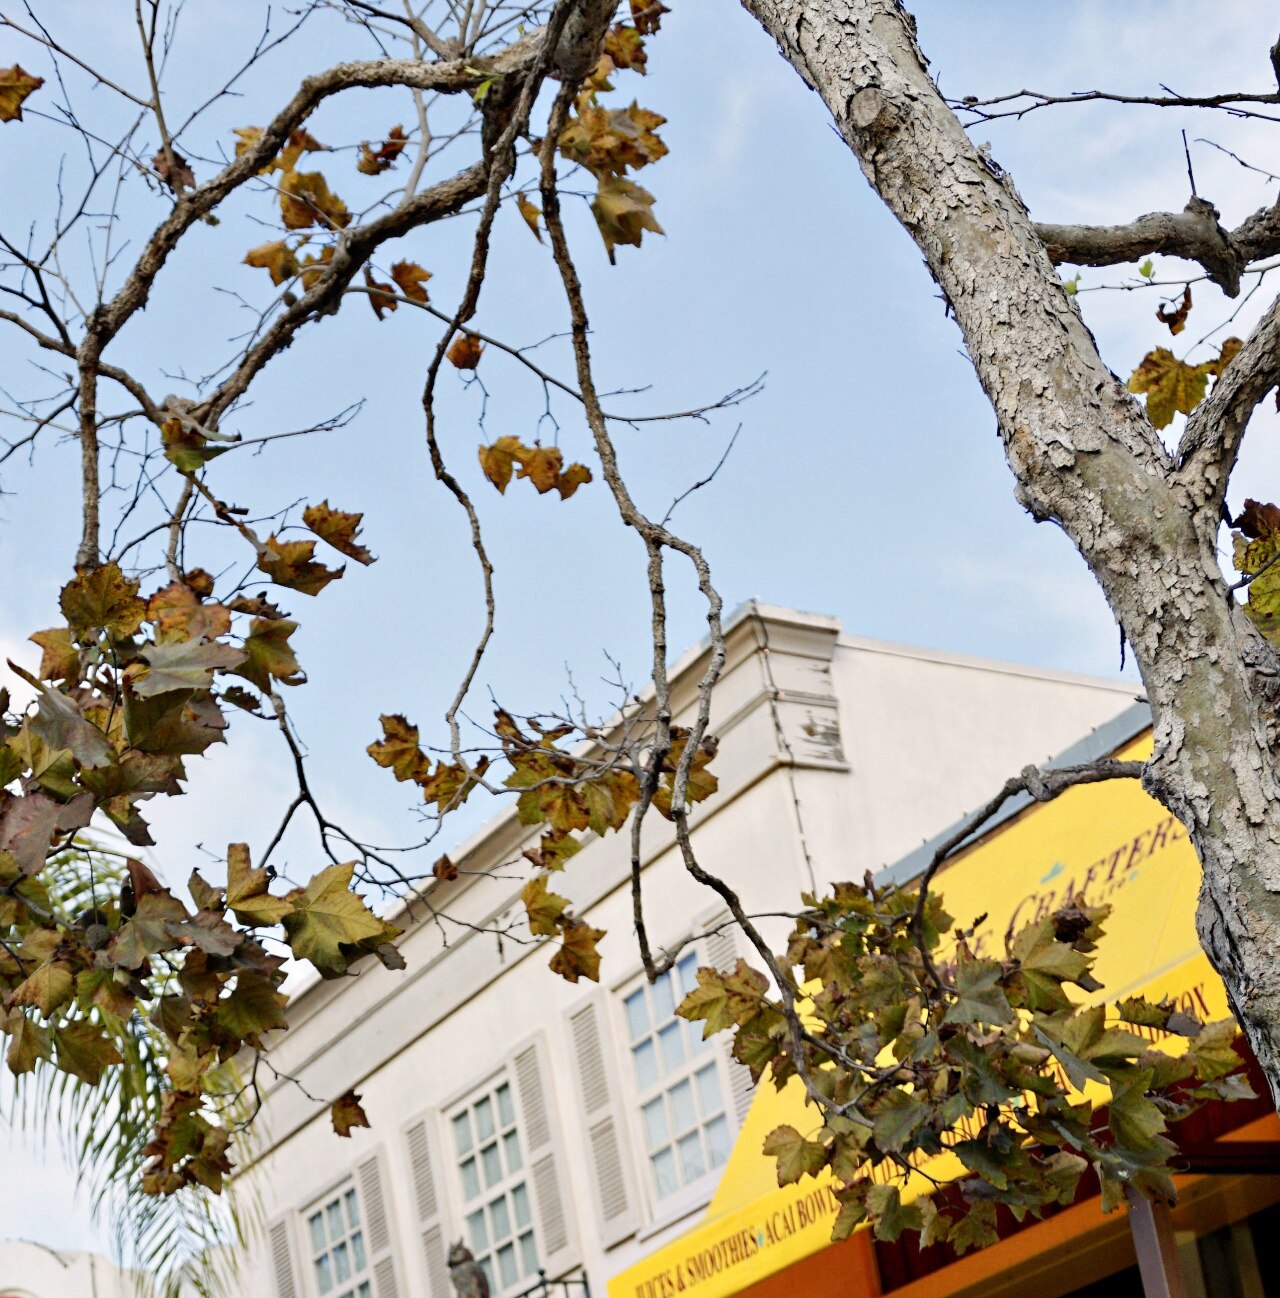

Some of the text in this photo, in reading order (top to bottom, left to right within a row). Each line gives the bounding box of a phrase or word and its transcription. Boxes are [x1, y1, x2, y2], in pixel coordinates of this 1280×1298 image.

[674, 1268, 686, 1292] &
[687, 1225, 760, 1288] SMOOTHIES
[763, 1209, 796, 1248] ACAI
